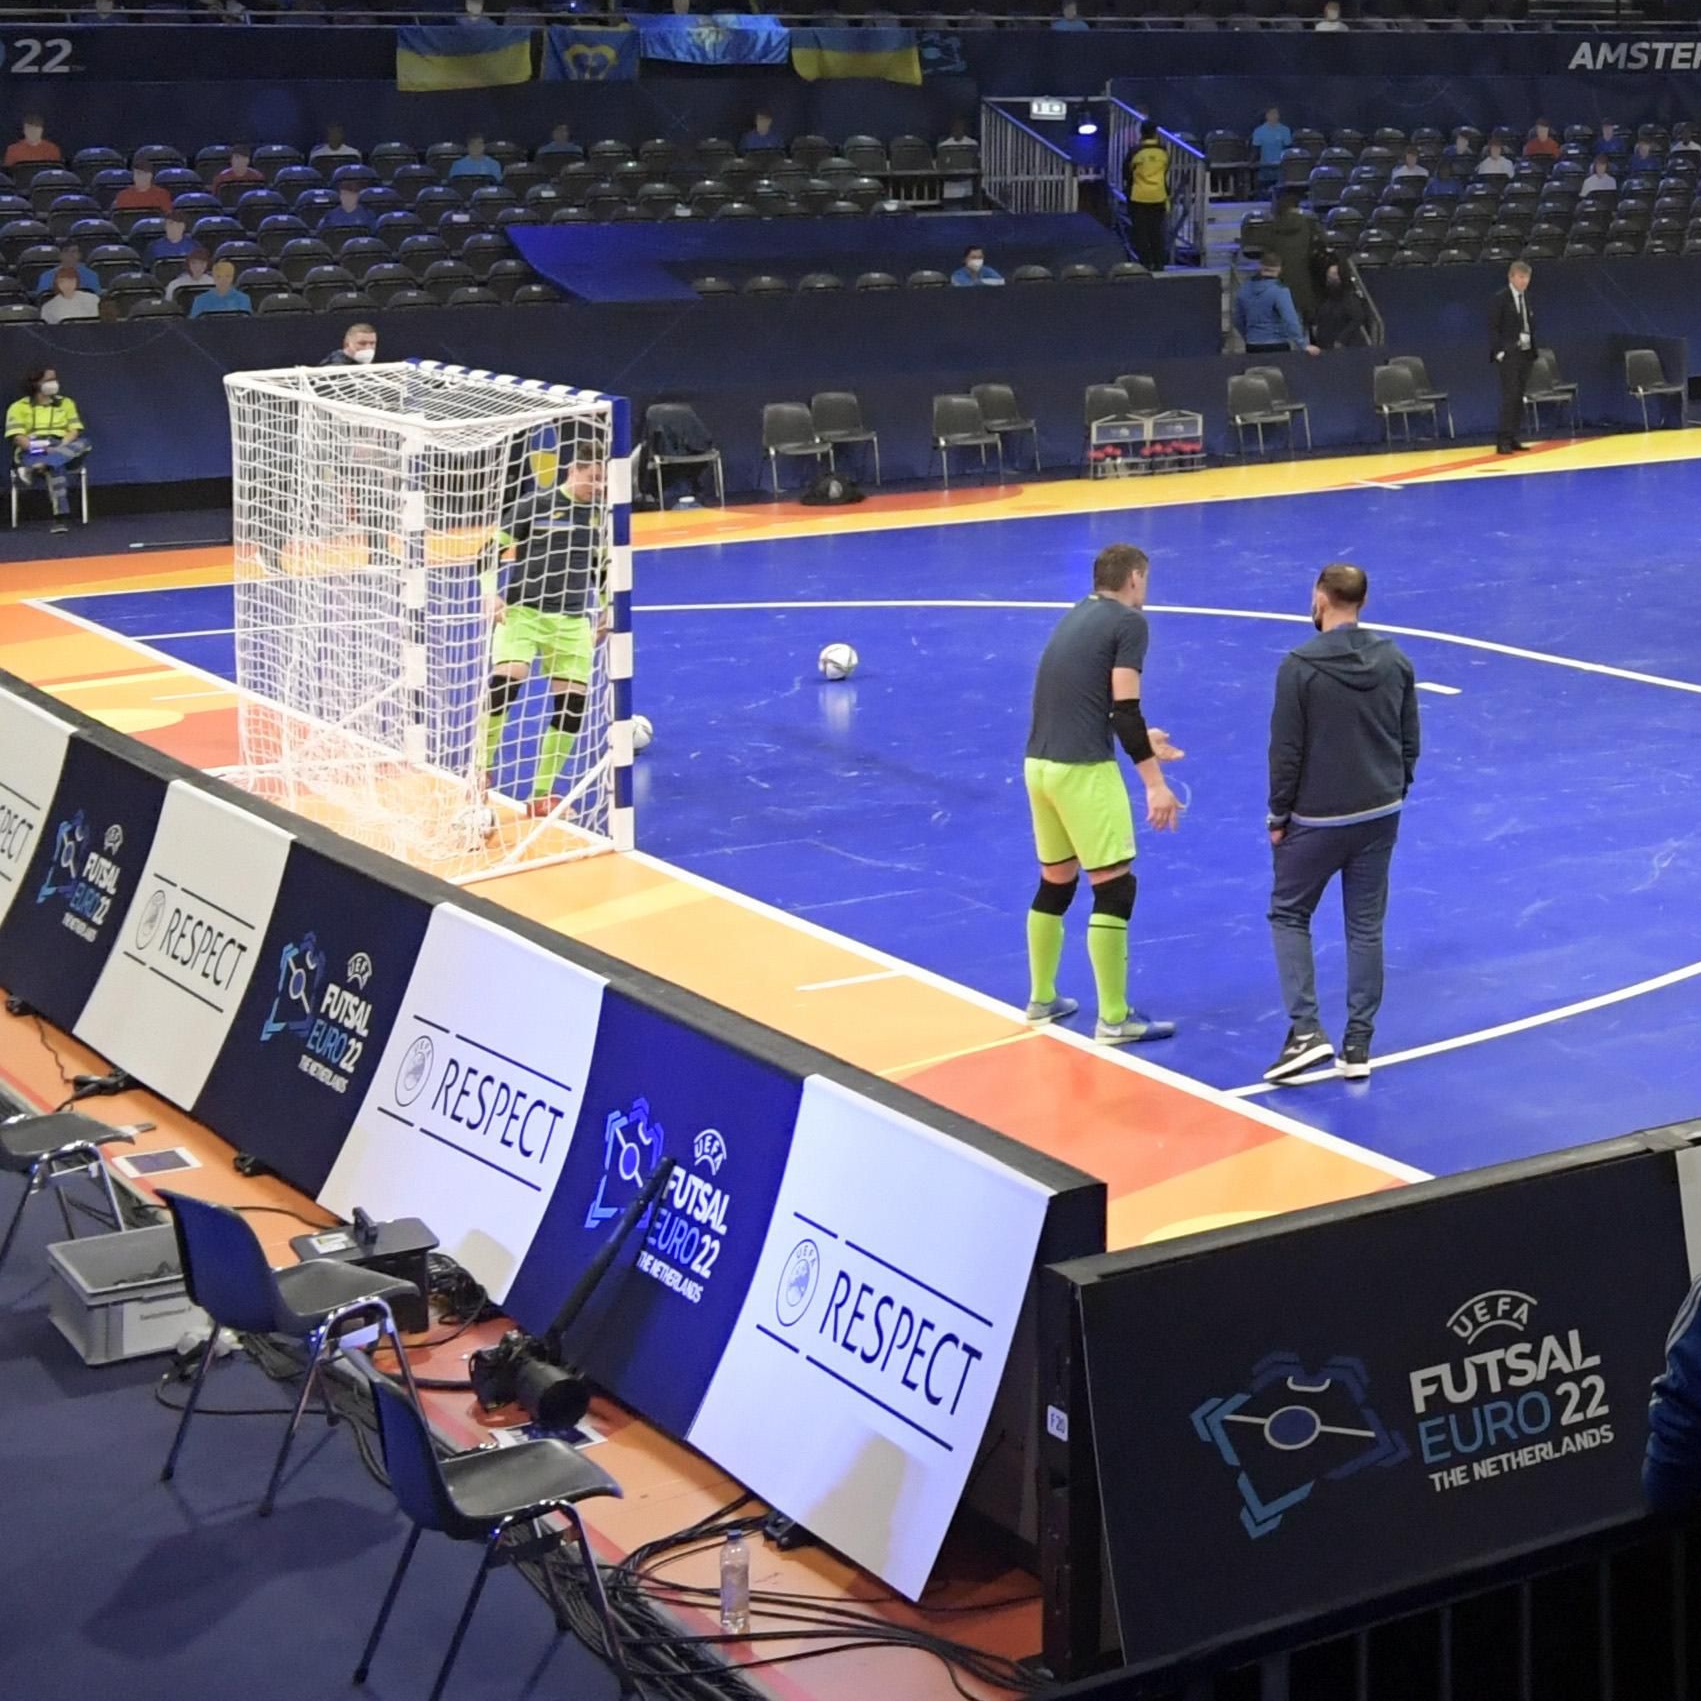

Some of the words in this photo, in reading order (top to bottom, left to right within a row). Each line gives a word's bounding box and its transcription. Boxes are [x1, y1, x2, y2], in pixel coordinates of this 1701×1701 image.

[11, 39, 72, 73] 22
[158, 907, 248, 991] RESPECT
[320, 983, 372, 1037] FUTSAL
[306, 1019, 348, 1064] EURO
[339, 1037, 363, 1074] 22
[431, 1057, 565, 1164] RESPECT
[663, 1165, 730, 1235] FUTSAL
[648, 1208, 700, 1265] EURO
[690, 1234, 720, 1279] 22
[651, 1260, 704, 1304] NETHERLANDS
[819, 1269, 983, 1416] RESPECT
[1452, 1297, 1530, 1338] UEFA
[1409, 1328, 1601, 1414] FUTSAL
[1418, 1390, 1551, 1465] EURO
[1555, 1374, 1610, 1426] 22
[1428, 1464, 1470, 1492] THE
[1472, 1423, 1615, 1481] NETHERLANDS
